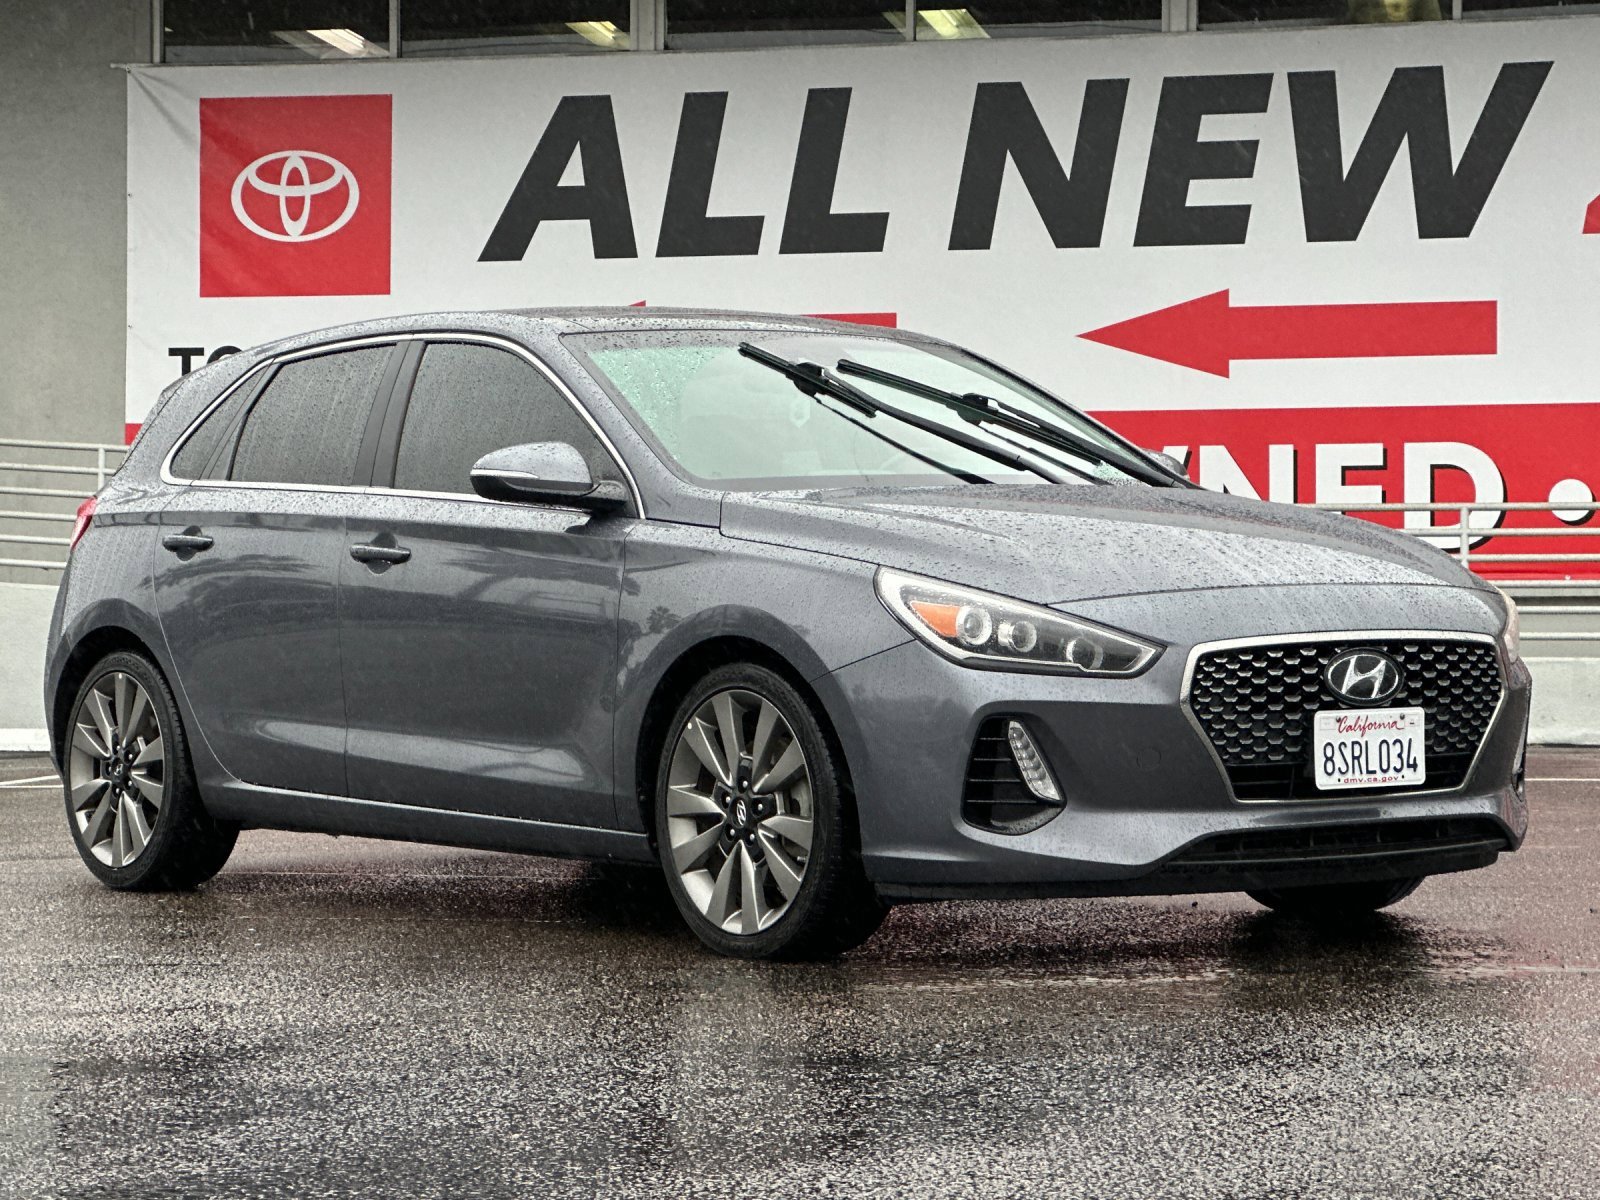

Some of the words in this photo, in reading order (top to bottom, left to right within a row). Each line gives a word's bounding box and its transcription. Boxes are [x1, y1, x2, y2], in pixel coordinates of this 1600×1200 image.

[477, 86, 890, 262] ALL
[948, 60, 1555, 250] NEW
[1337, 714, 1405, 738] California
[1323, 737, 1418, 777] 8SRL034
[1344, 775, 1399, 784] dmv.ca.gov
